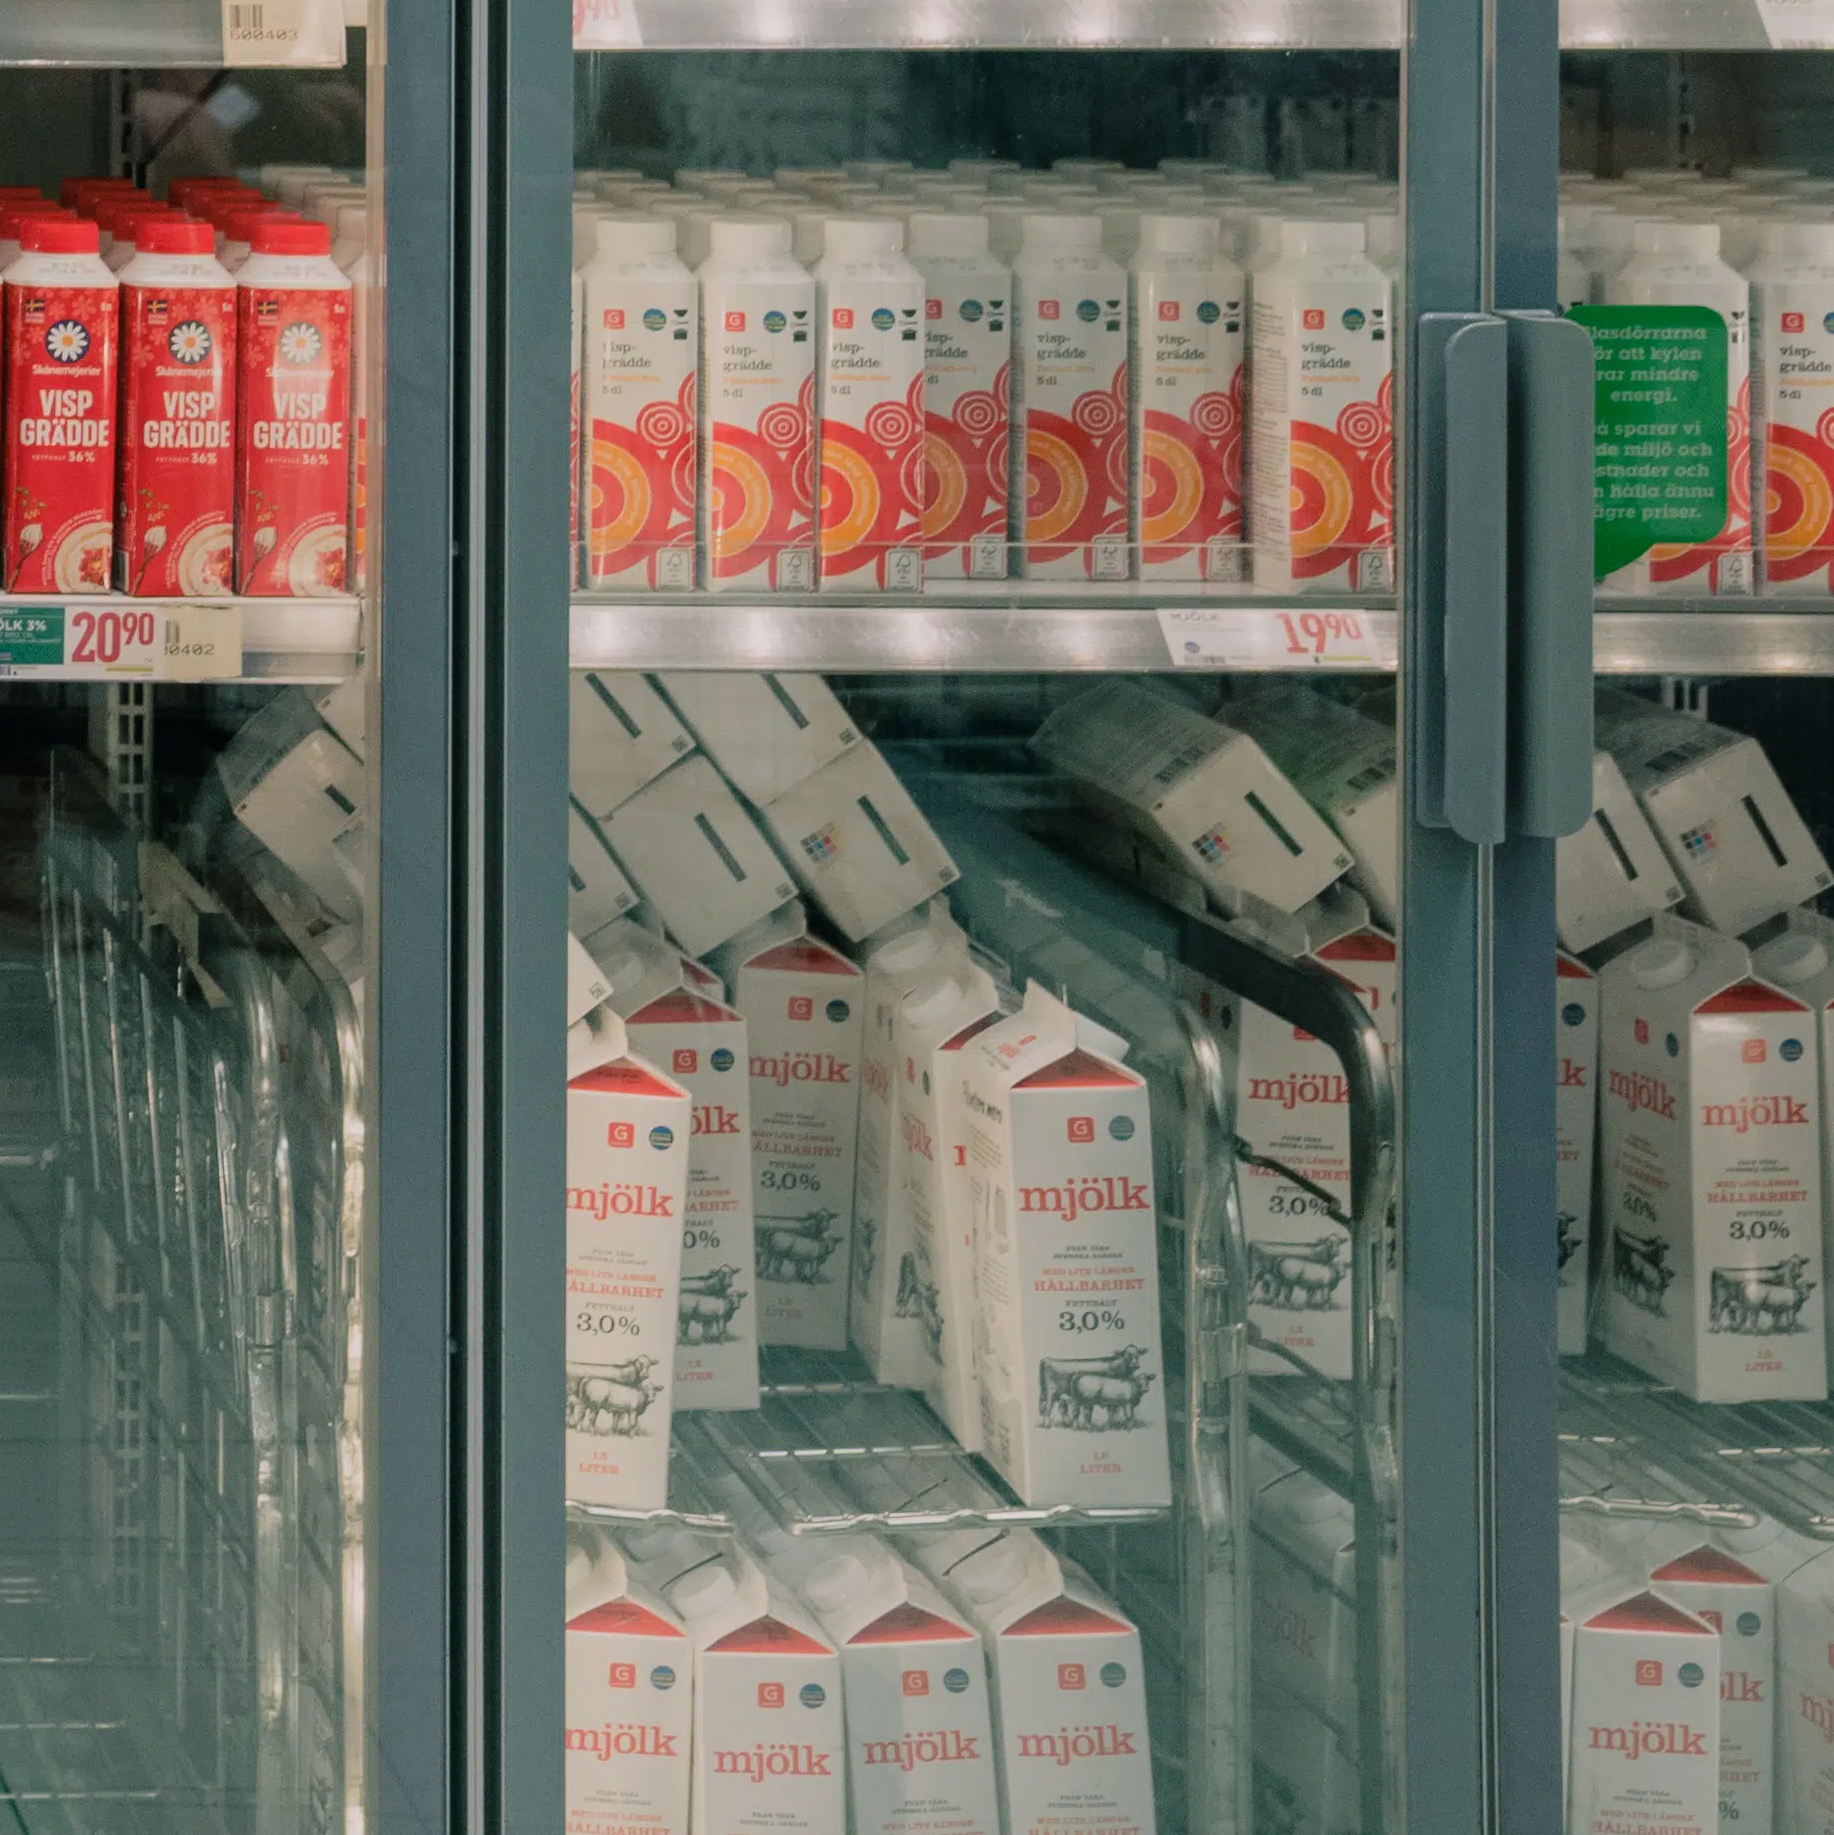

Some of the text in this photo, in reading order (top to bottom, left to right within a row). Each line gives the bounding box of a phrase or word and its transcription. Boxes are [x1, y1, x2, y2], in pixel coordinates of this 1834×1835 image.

[27, 620, 46, 631] 3%
[72, 612, 154, 662] 2090
[1282, 611, 1362, 654] 1990
[1702, 1096, 1809, 1133] mjölk
[1019, 1175, 1150, 1222] mjölk
[1729, 1221, 1789, 1241] 3,0%
[1059, 1310, 1125, 1334] 3,0%
[863, 1730, 980, 1771] mjölk
[1588, 1722, 1707, 1760] mjölk
[714, 1744, 831, 1785] mjölk
